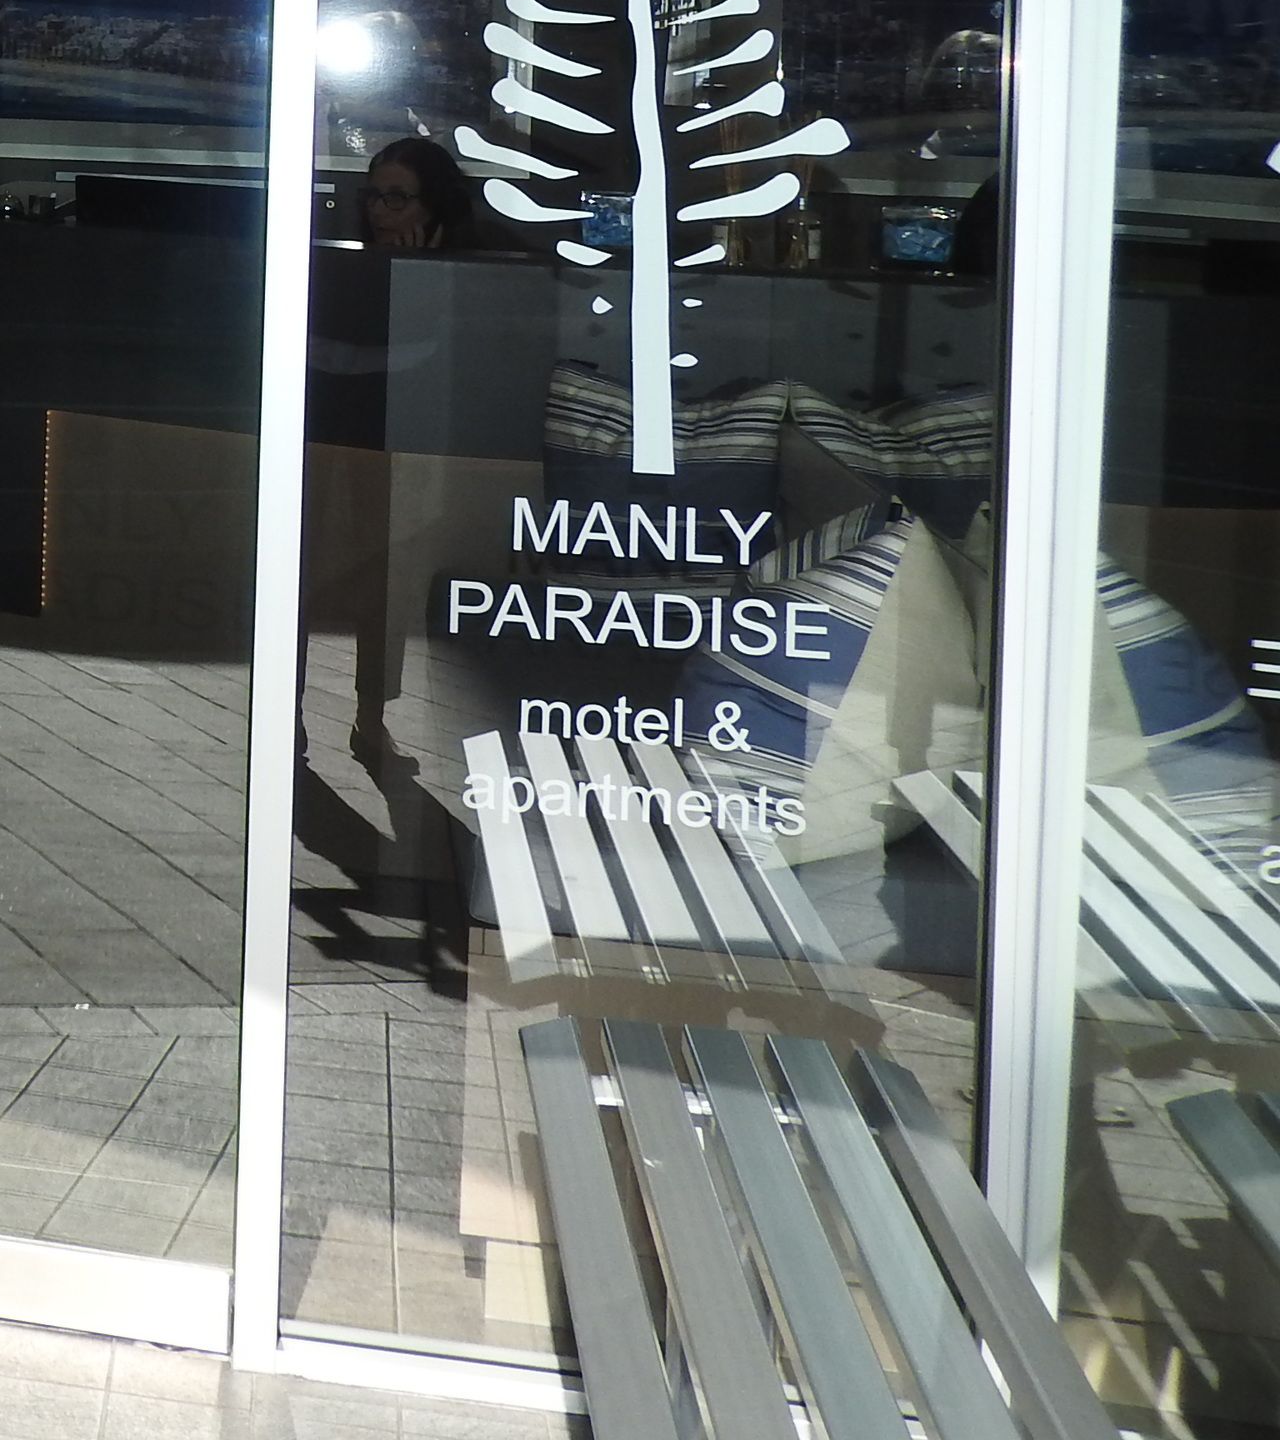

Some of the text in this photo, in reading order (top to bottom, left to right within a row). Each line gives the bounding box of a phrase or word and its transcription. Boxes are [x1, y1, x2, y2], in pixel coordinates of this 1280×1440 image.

[513, 496, 772, 566] MANLY
[448, 579, 831, 660] PARADISE
[519, 695, 752, 753] motel &
[461, 771, 807, 836] apartments
